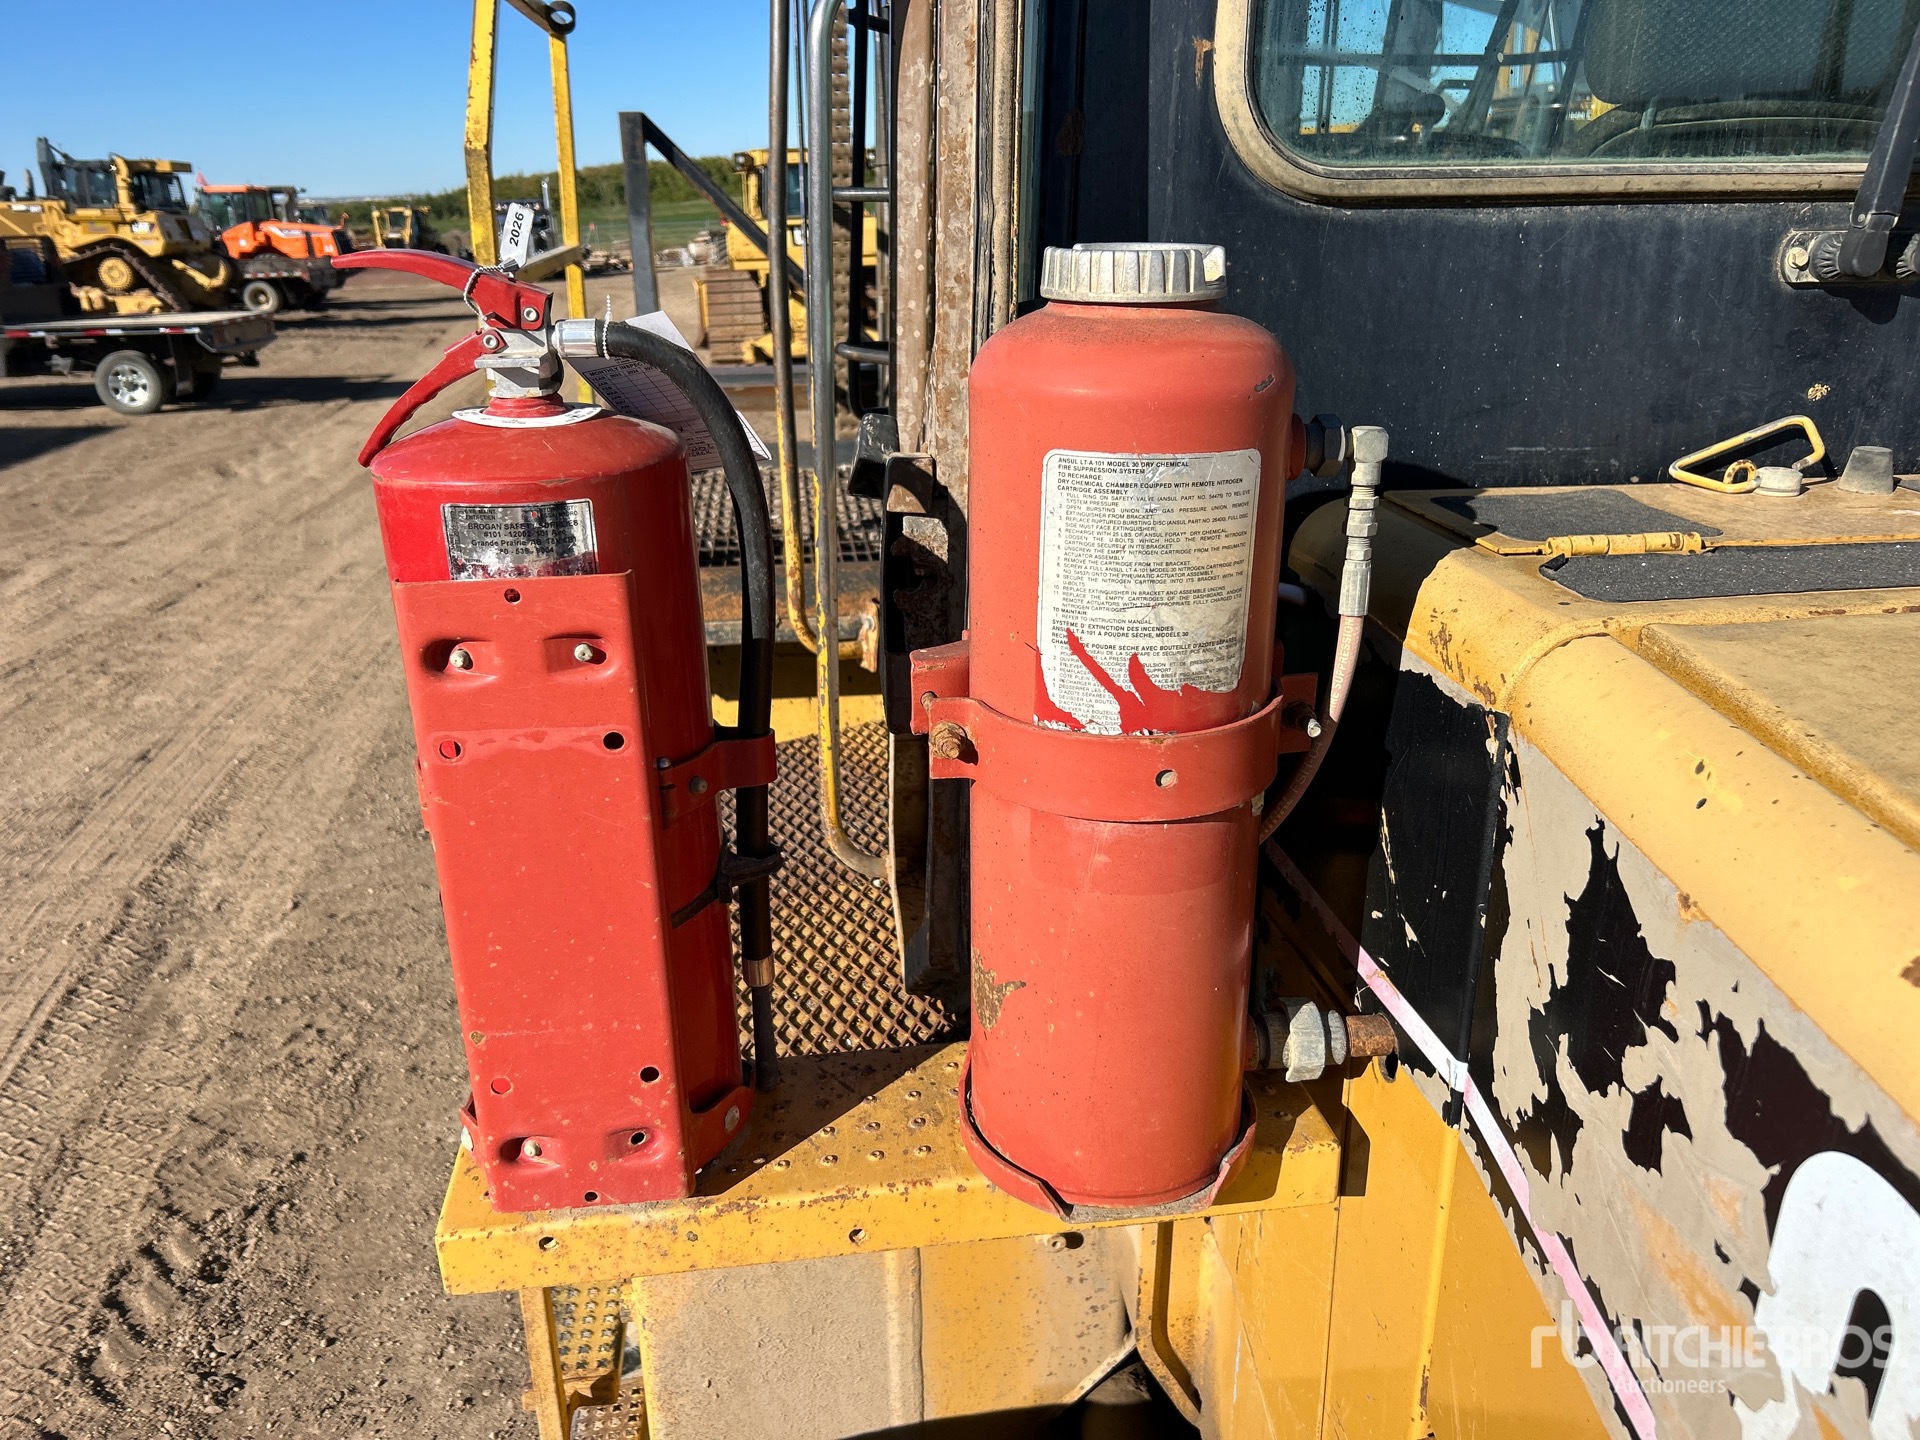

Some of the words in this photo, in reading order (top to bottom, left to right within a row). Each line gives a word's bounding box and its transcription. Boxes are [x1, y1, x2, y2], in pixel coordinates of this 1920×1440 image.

[509, 212, 524, 247] 2026
[589, 367, 618, 376] MONTHLY
[1073, 466, 1117, 474] SUPPRESSION
[1216, 478, 1243, 486] NITROGEN
[1057, 485, 1091, 493] CARTRIDGE
[1065, 510, 1106, 518] EXTINGUISHER
[504, 522, 534, 530] SAFET
[484, 531, 501, 539] #101
[471, 539, 499, 547] Grande
[1334, 619, 1355, 690] SUPPRESSION
